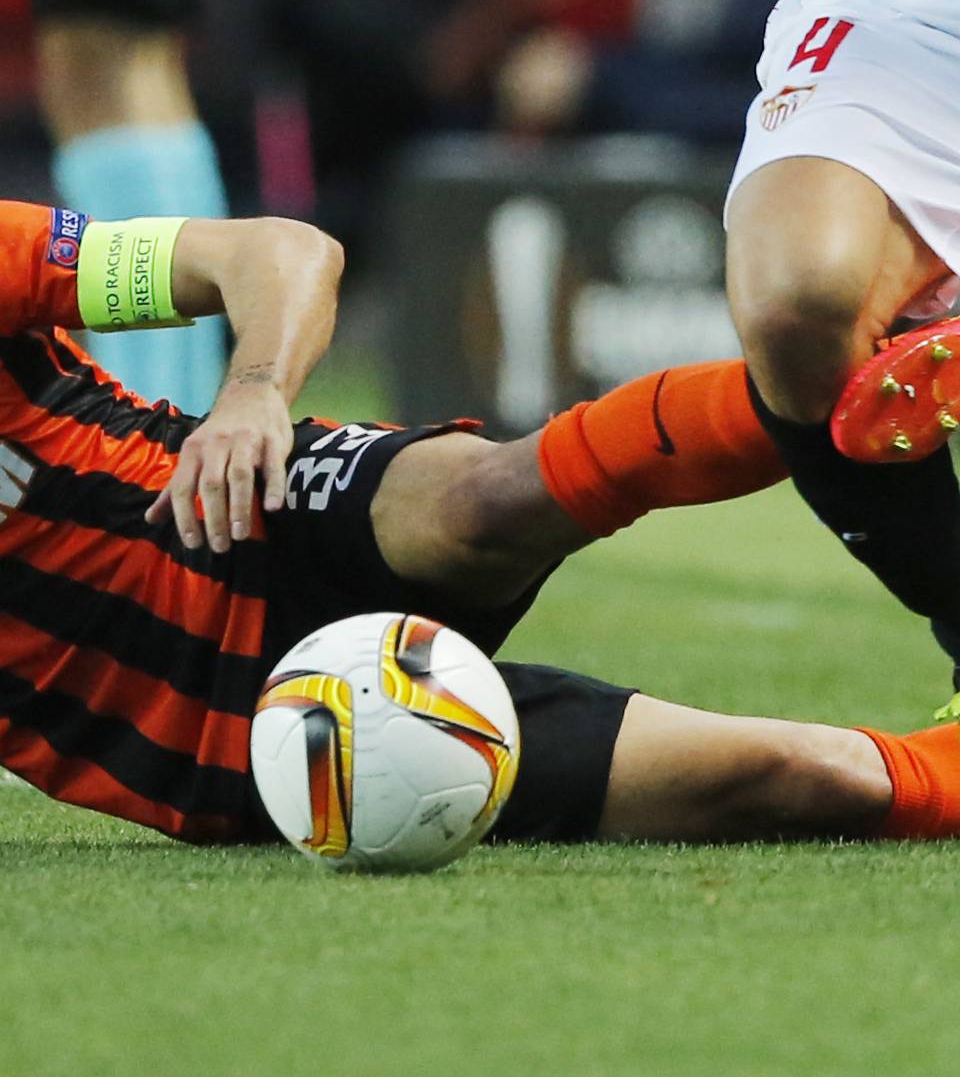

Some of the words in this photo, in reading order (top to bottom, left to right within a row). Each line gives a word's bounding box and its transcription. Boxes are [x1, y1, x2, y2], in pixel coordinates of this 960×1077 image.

[786, 16, 855, 73] 4
[61, 209, 79, 239] RES
[106, 231, 126, 289] RACISM
[134, 237, 152, 306] RESPECT
[106, 293, 122, 316] TO
[286, 424, 384, 511] 33
